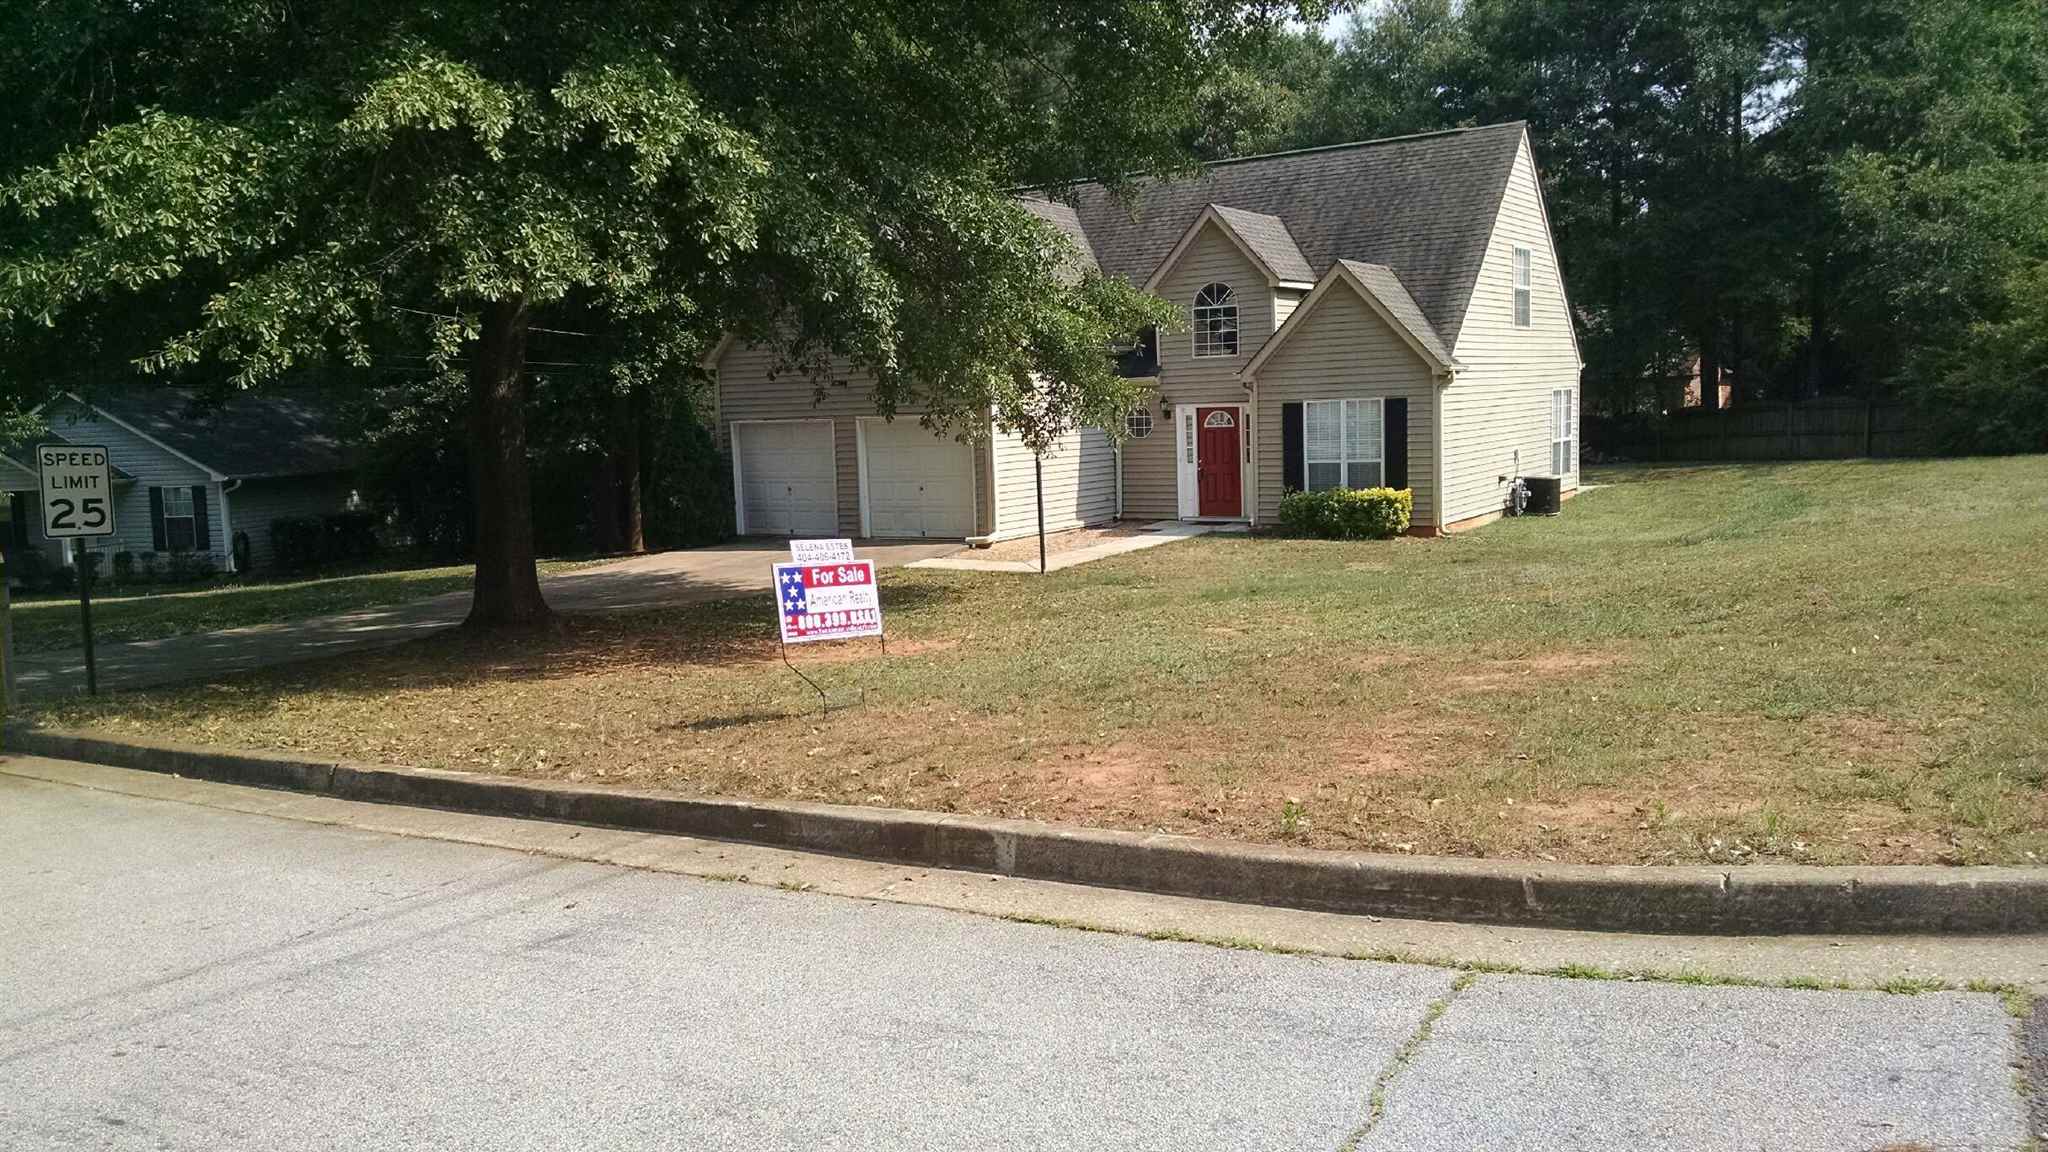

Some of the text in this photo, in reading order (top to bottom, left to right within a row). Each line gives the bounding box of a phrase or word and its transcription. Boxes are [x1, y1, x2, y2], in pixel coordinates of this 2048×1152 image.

[43, 452, 105, 466] SPEED
[51, 475, 99, 489] LIMIT
[49, 498, 106, 528] 25
[811, 566, 865, 585] For Sale
